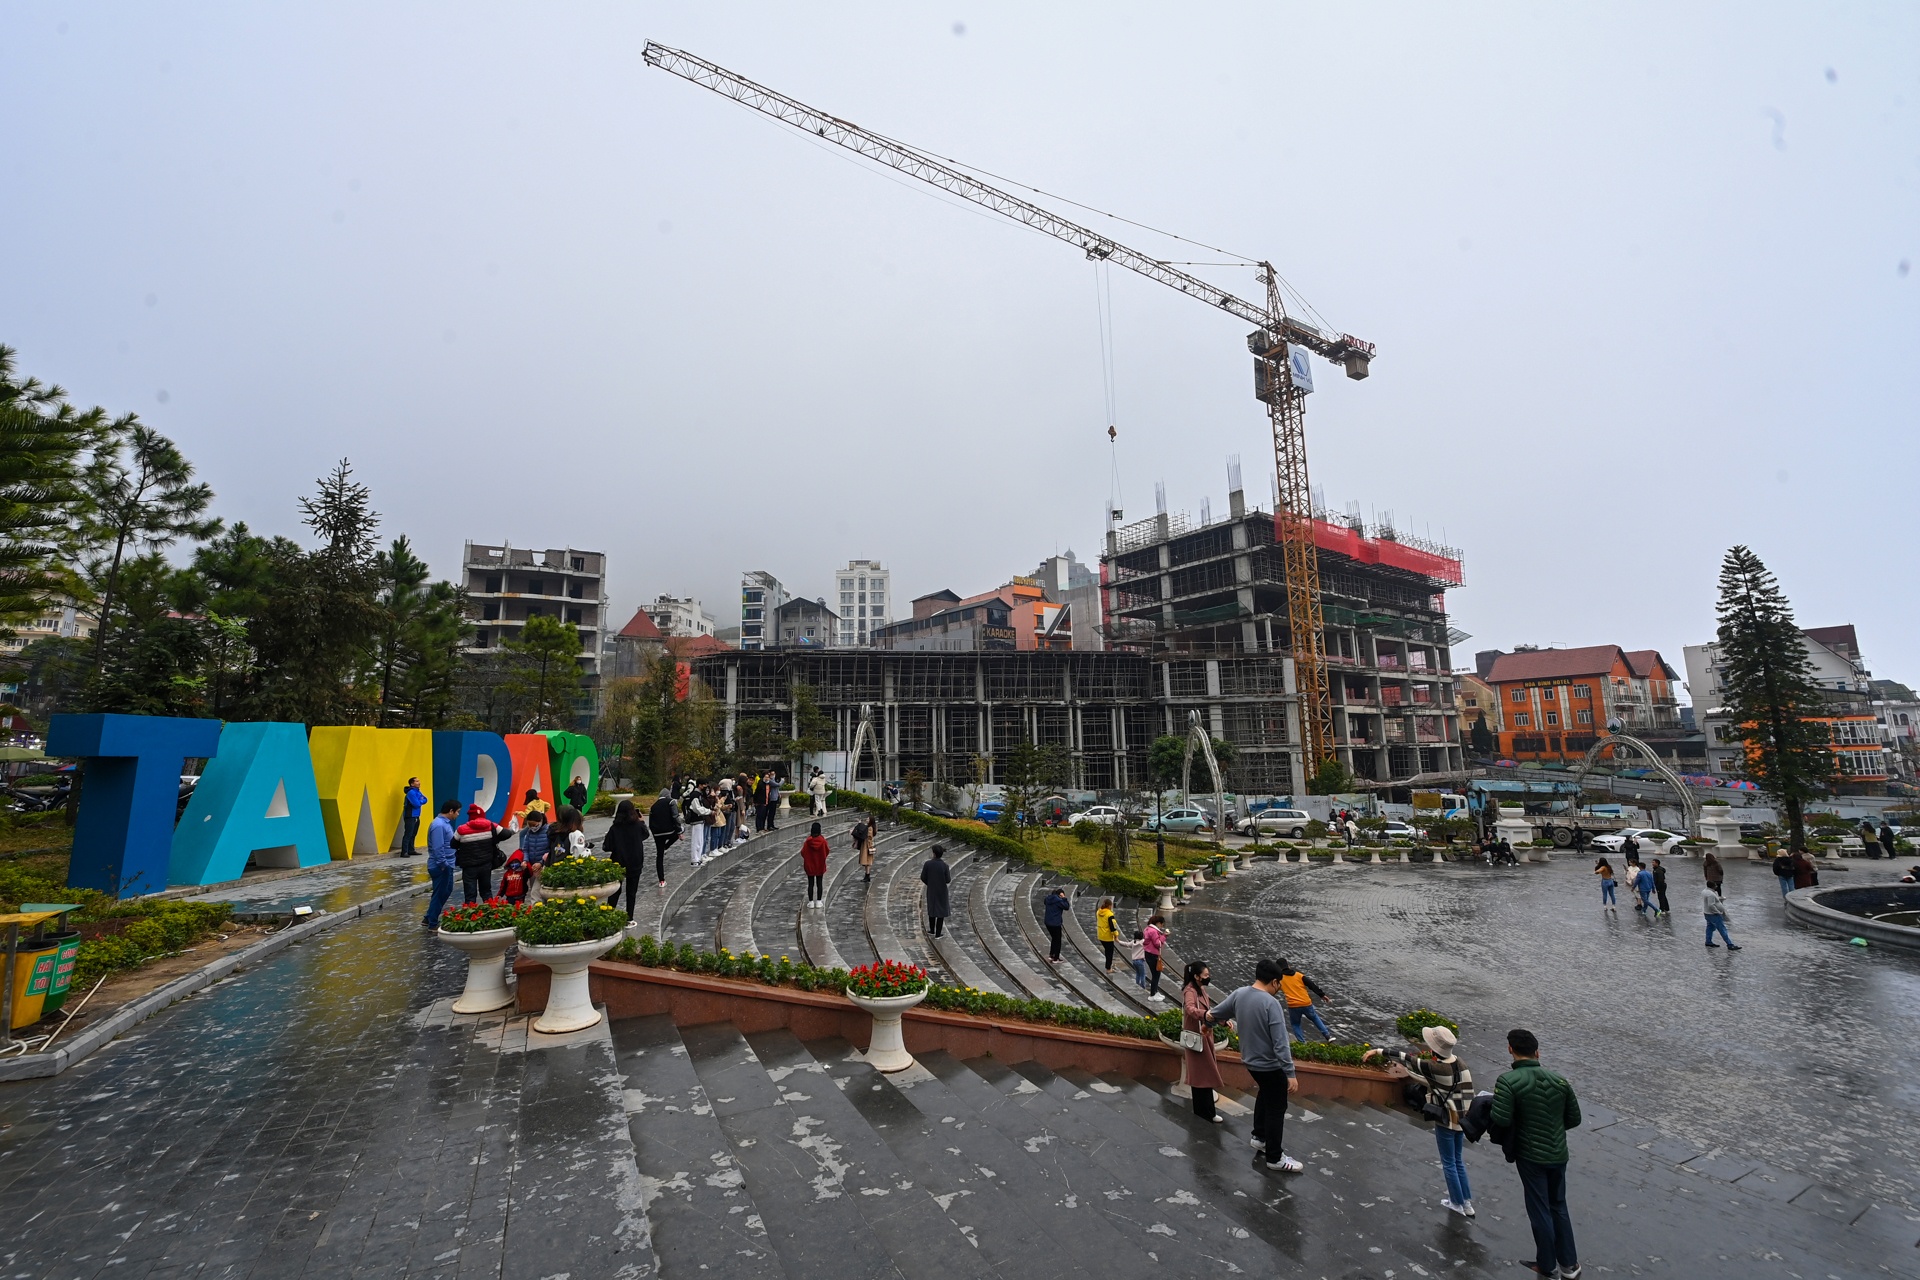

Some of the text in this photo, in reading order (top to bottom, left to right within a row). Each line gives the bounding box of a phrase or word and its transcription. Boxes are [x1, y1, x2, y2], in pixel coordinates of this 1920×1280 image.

[1342, 333, 1375, 352] GROUP
[986, 627, 1015, 640] KARAOKE
[45, 713, 433, 900] TAM
